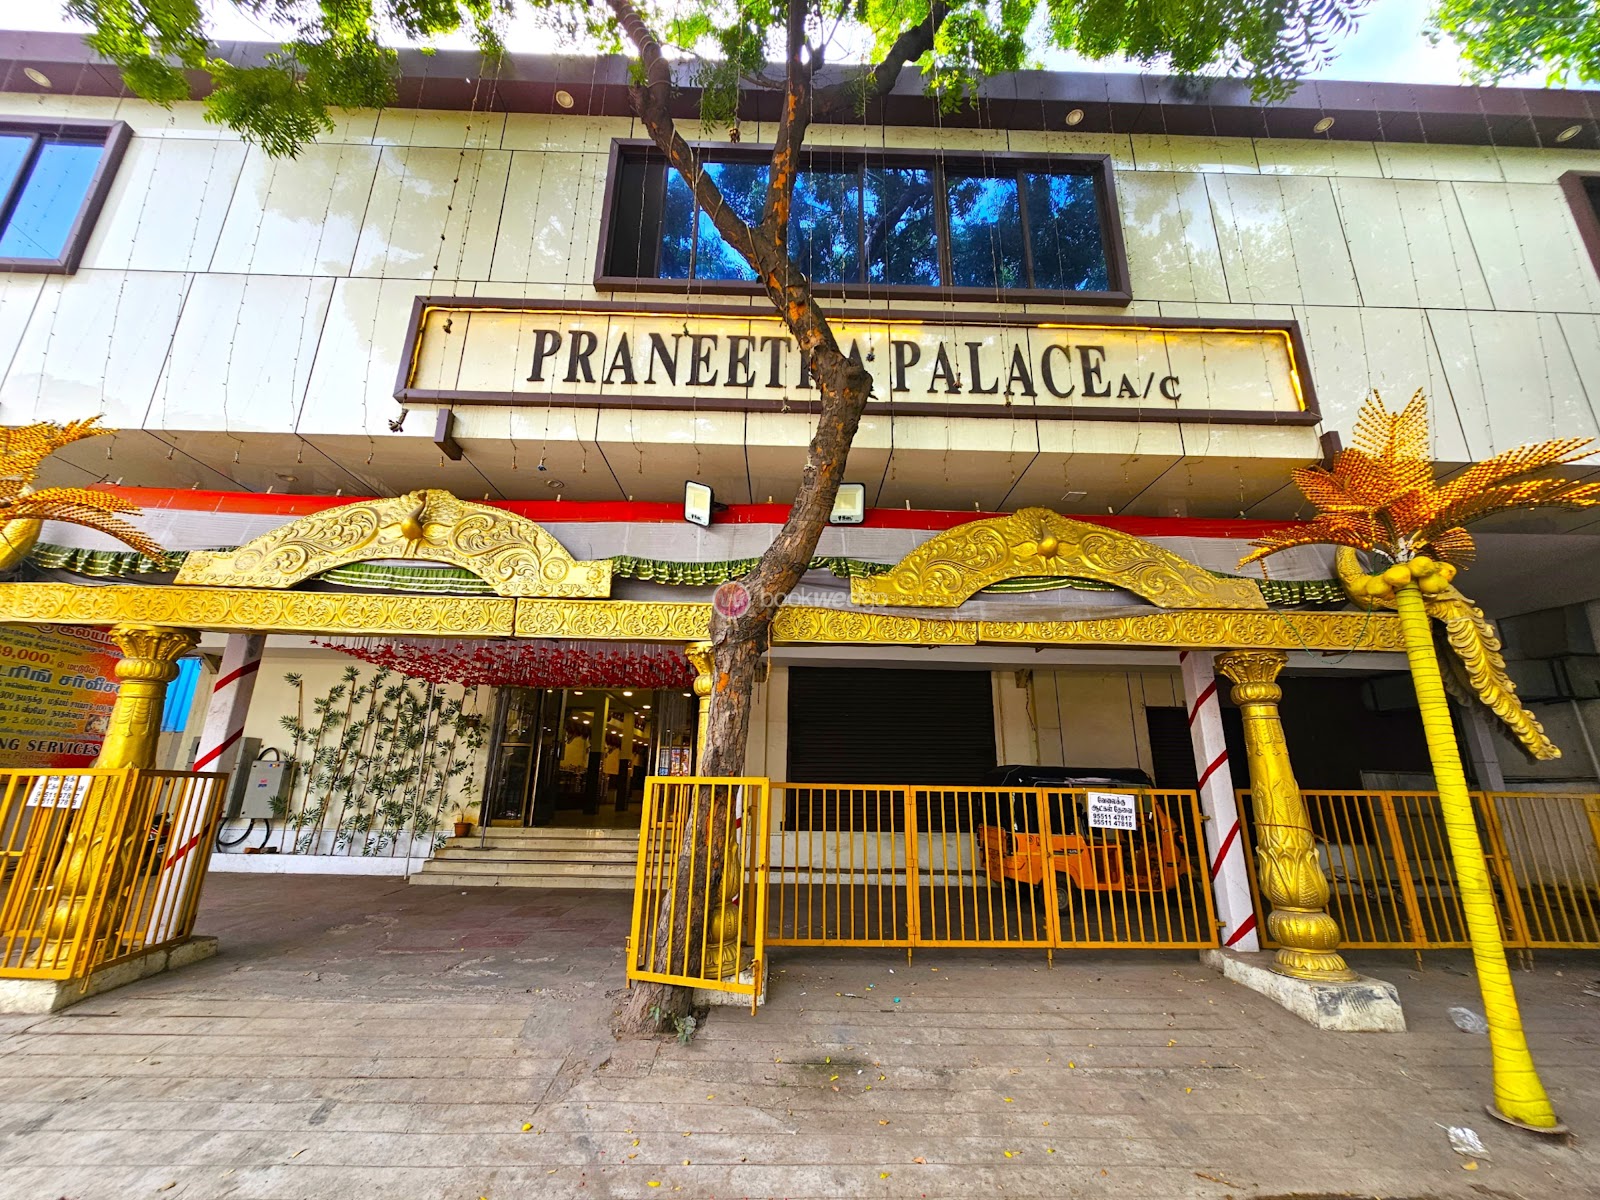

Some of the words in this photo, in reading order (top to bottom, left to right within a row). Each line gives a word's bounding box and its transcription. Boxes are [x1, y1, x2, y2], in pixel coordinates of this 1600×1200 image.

[892, 340, 1112, 399] PALACE
[1116, 372, 1182, 402] A/C
[0, 645, 51, 664] 9,000
[58, 674, 120, 694] சர்வீச
[26, 739, 101, 756] SERVICES
[1113, 814, 1132, 822] 47817
